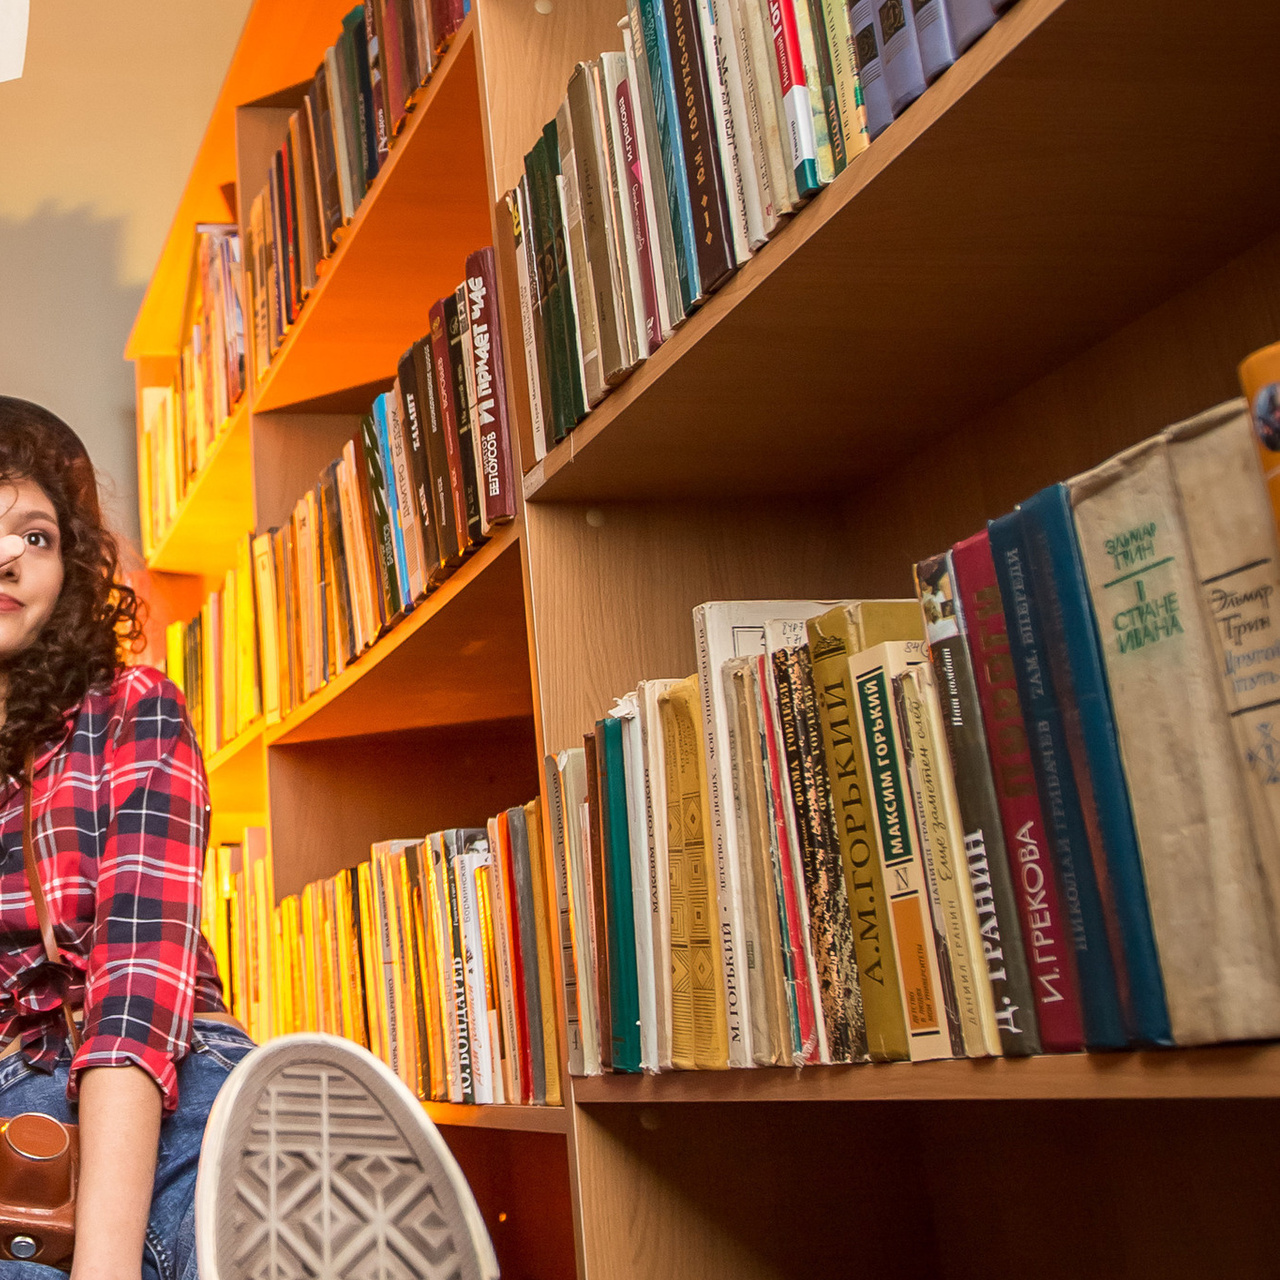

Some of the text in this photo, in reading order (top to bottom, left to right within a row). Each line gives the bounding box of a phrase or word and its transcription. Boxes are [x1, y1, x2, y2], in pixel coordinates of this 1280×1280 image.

[828, 15, 836, 33] НА
[830, 31, 842, 76] ВЕЧЕРА
[774, 33, 790, 89] Николай
[788, 117, 801, 161] Ревизор
[826, 98, 842, 163] ГОГОЛЬ
[467, 270, 495, 426] И ПРИДЕТ ЧАС
[437, 355, 448, 409] ВОРОБЬЕВ
[405, 389, 420, 453] ТАЛАНТ
[481, 435, 489, 473] ВИКТОР
[391, 405, 410, 518] ДМИТРО БЕДЗИК
[484, 430, 501, 497] БЕЛОУСОВ
[1104, 522, 1157, 554] ЭЛЬМАР
[1113, 543, 1156, 571] ГРИН
[1006, 547, 1035, 644] ВПЕРЕДИ
[1211, 584, 1274, 613] Эльмар
[1217, 613, 1272, 647] Грин
[697, 628, 712, 724] УНИВЕРСИТЕТЫ
[939, 646, 964, 726] Наш комбат
[971, 580, 1037, 799] ПОРОГИ
[778, 682, 798, 751] ГОРДЕЕВ
[801, 685, 821, 754] ГОРДЕЕВ
[790, 763, 805, 805] ФОМА
[813, 764, 828, 810] ФОМА
[862, 678, 904, 855] МАКСИМ ГОРЬКИЙ
[1036, 719, 1068, 831] ГРИБАЧЕВ
[550, 772, 569, 896] Борис Горбатов
[642, 767, 659, 912] МАКСИМ ГОРЬКИЙ
[825, 675, 884, 990] А.М.ГОРЬКИЙ
[909, 701, 977, 1024] ДАНИИЛ ГРАНИН Еще заметен след
[457, 858, 471, 922] Борминская
[1056, 835, 1089, 952] НИКОЛАЙ
[960, 827, 1022, 1035] Д. ГРАНИН
[719, 921, 739, 1015] ГОРЬКИЙ
[916, 987, 925, 1015] ЛЮДЯХ
[917, 943, 934, 1022] МОИ УНИВЕРСИТЕТЫ
[450, 956, 471, 1064] БОНДАРЕВ
[729, 1020, 741, 1042] М.
[908, 990, 918, 1024] ДЕТСТВО
[460, 1068, 473, 1095] Ю.
